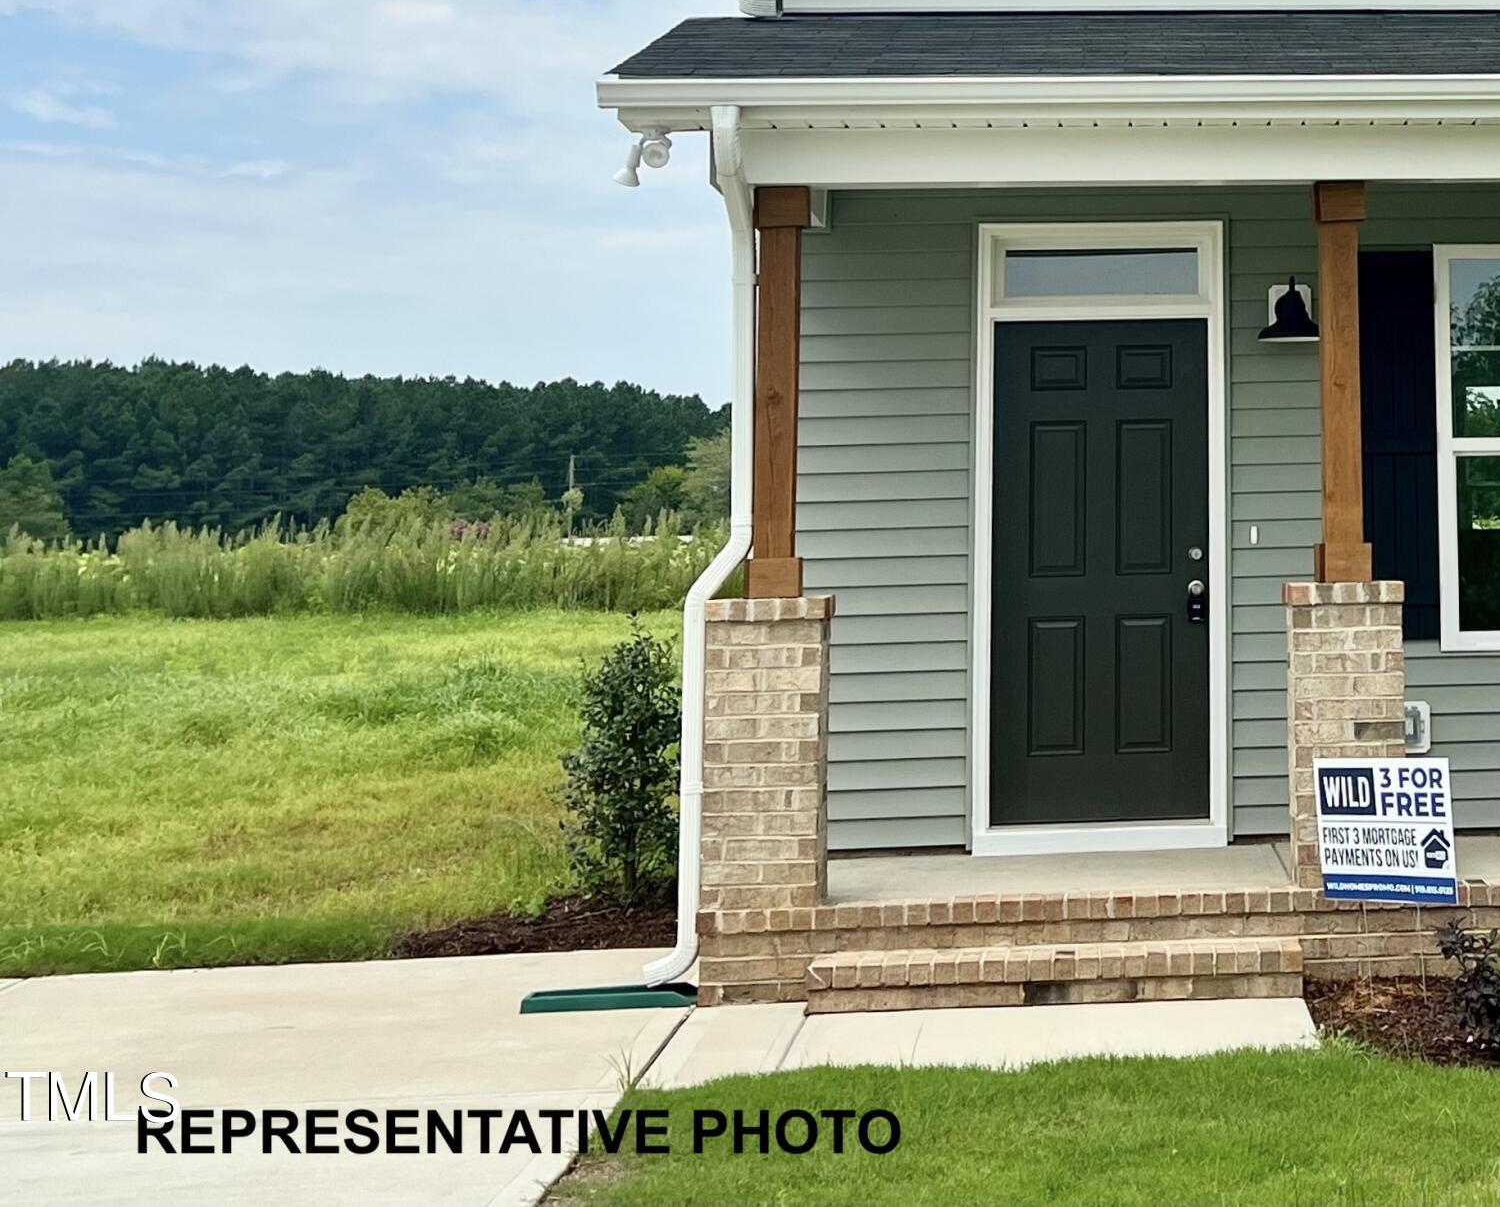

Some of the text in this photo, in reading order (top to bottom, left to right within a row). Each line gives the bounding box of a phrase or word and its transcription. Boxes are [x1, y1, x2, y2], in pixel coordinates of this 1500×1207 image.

[1379, 767, 1443, 789] 3 FOR
[1322, 776, 1371, 808] WILD
[1380, 792, 1446, 817] FREE
[1322, 827, 1417, 846] FIRST 3 MORTGAGE
[1324, 848, 1418, 868] PAYMENTS ON US!
